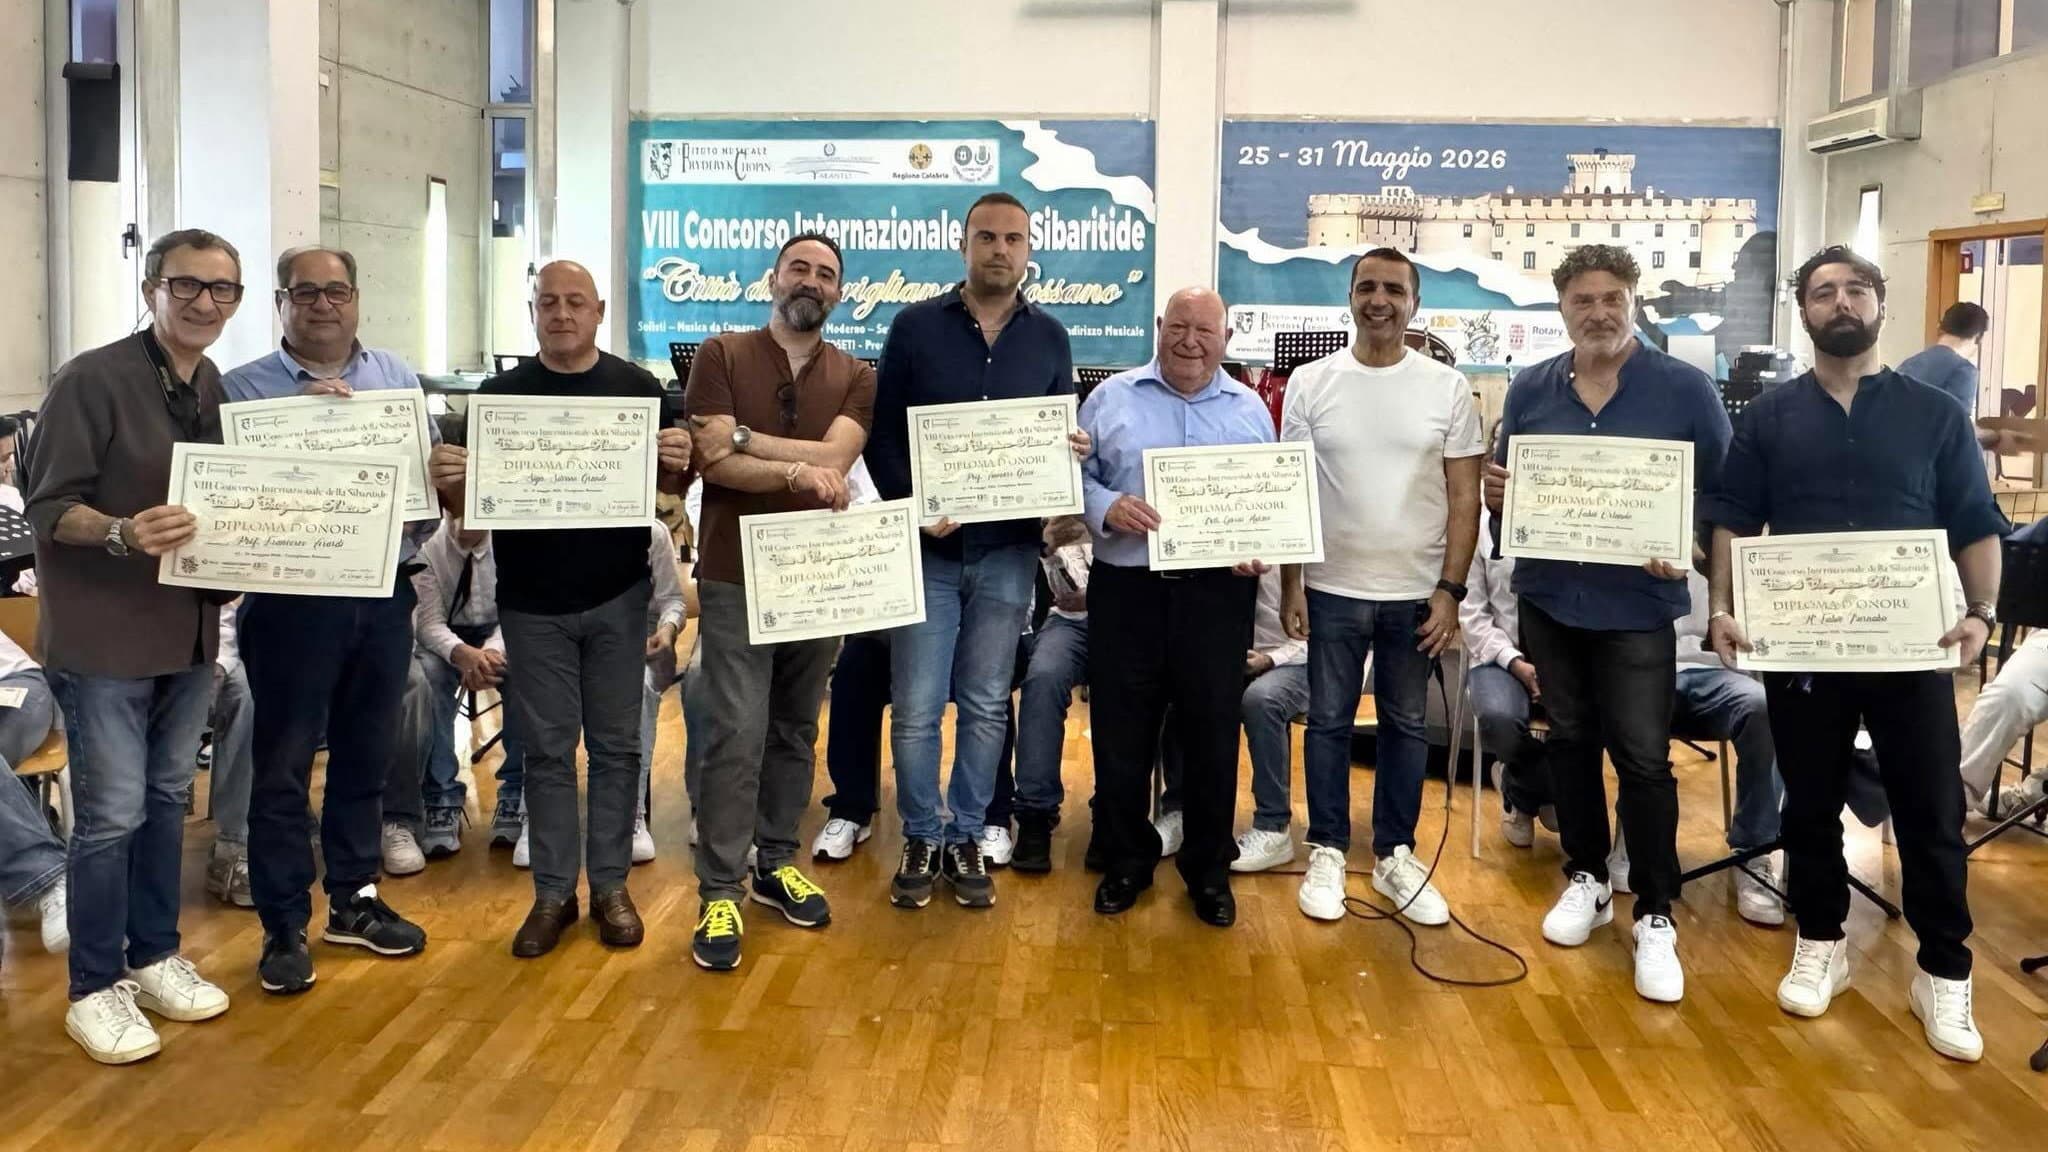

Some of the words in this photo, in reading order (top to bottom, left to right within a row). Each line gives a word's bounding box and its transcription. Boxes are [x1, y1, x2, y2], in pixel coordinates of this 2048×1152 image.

[1238, 146, 1270, 165] 25
[1297, 147, 1323, 166] 31
[1331, 139, 1432, 180] Maggio
[1439, 149, 1507, 169] 2026
[641, 210, 681, 250] VIII
[684, 209, 790, 250] Concorso
[1029, 205, 1145, 251] Sibaritide
[638, 321, 667, 333] Solisti
[677, 321, 708, 333] Musica
[710, 322, 721, 333] da
[825, 323, 866, 335] Moderno
[1065, 325, 1103, 337] ndirizzo
[1104, 325, 1145, 337] Musicale
[1532, 326, 1564, 337] Rotary
[503, 460, 562, 470] DIPLOMA
[1536, 494, 1597, 507] DIPLOMA
[213, 519, 287, 534] DIPLOMA
[1772, 600, 1842, 611] DIPLOMA
